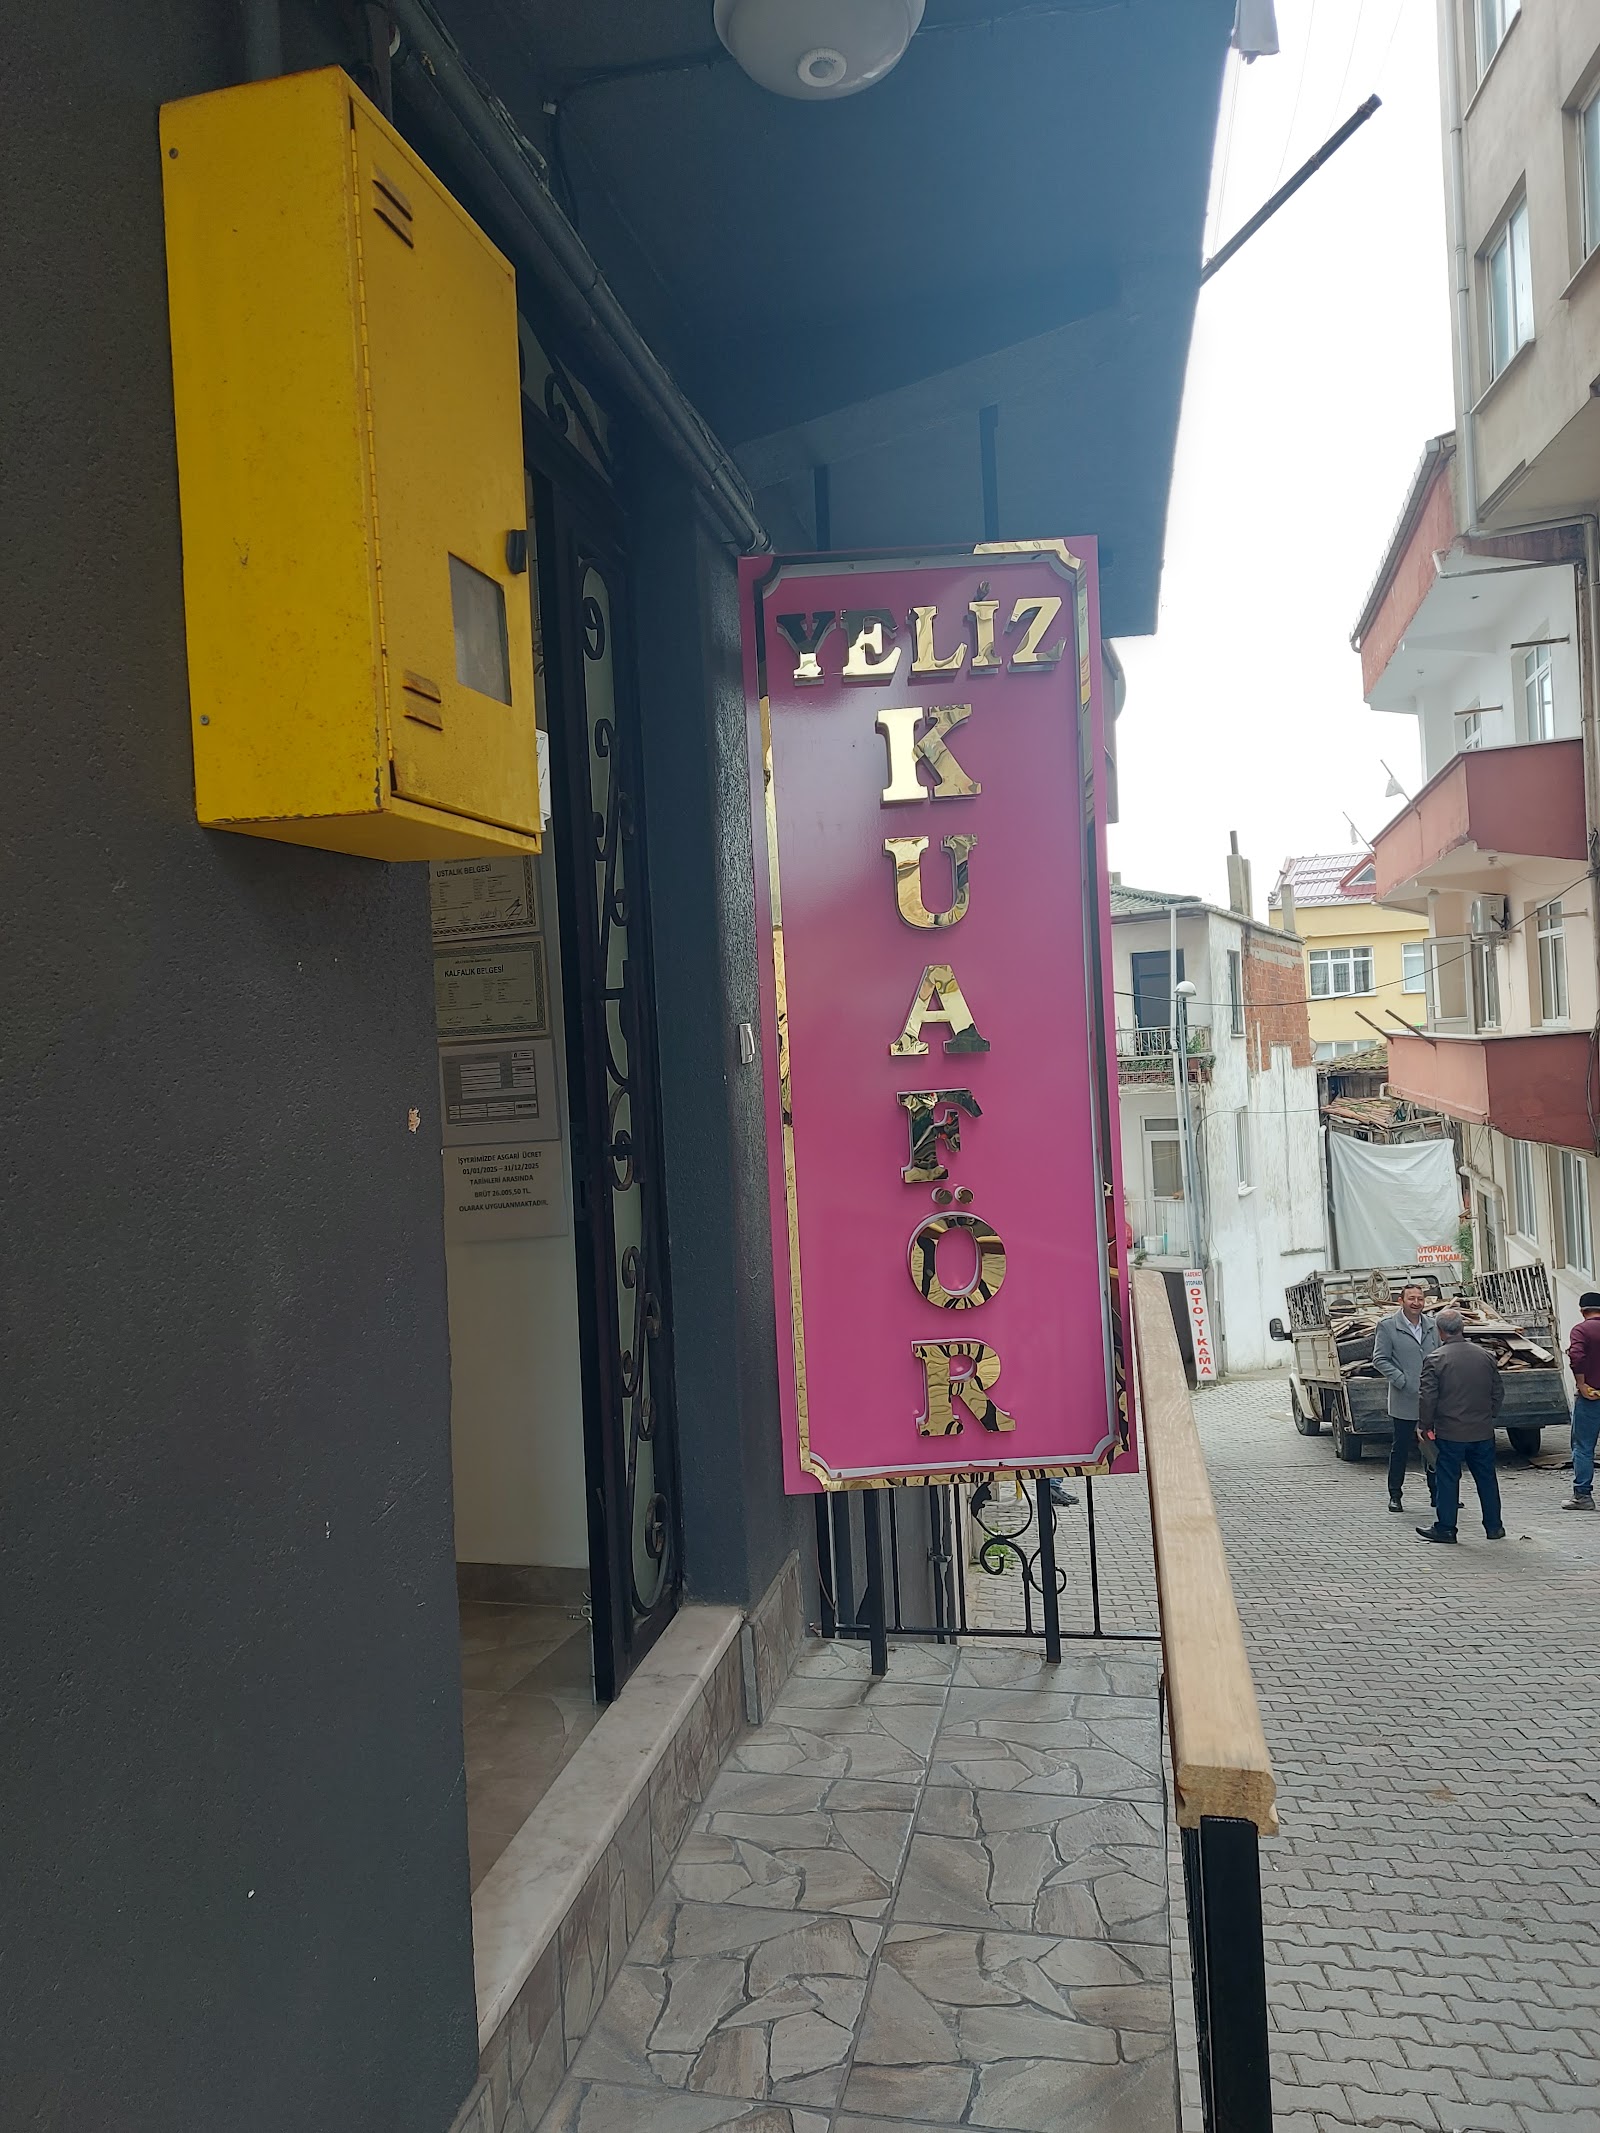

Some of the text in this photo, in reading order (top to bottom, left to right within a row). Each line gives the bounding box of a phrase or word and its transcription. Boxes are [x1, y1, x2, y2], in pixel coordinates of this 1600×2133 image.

[776, 580, 1067, 683] YELİZ
[436, 863, 492, 878] USTALIK BELGESİ
[444, 968, 476, 978] KALFALIK
[875, 703, 1016, 1437] KUAFÖR
[497, 1151, 520, 1161] ASGARİ
[522, 1150, 543, 1159] ÜCRET
[462, 1166, 498, 1175] 01/01/2025
[504, 1162, 539, 1172] 31/12/2025
[469, 1174, 534, 1186] TARİHLERİ ARASINDA
[474, 1190, 491, 1198] BRÜT
[458, 1203, 484, 1212] OLARAK
[1417, 1245, 1453, 1254] OTOPARK
[1418, 1255, 1433, 1263] OTO
[1190, 1288, 1212, 1375] OTO YIKAMA
